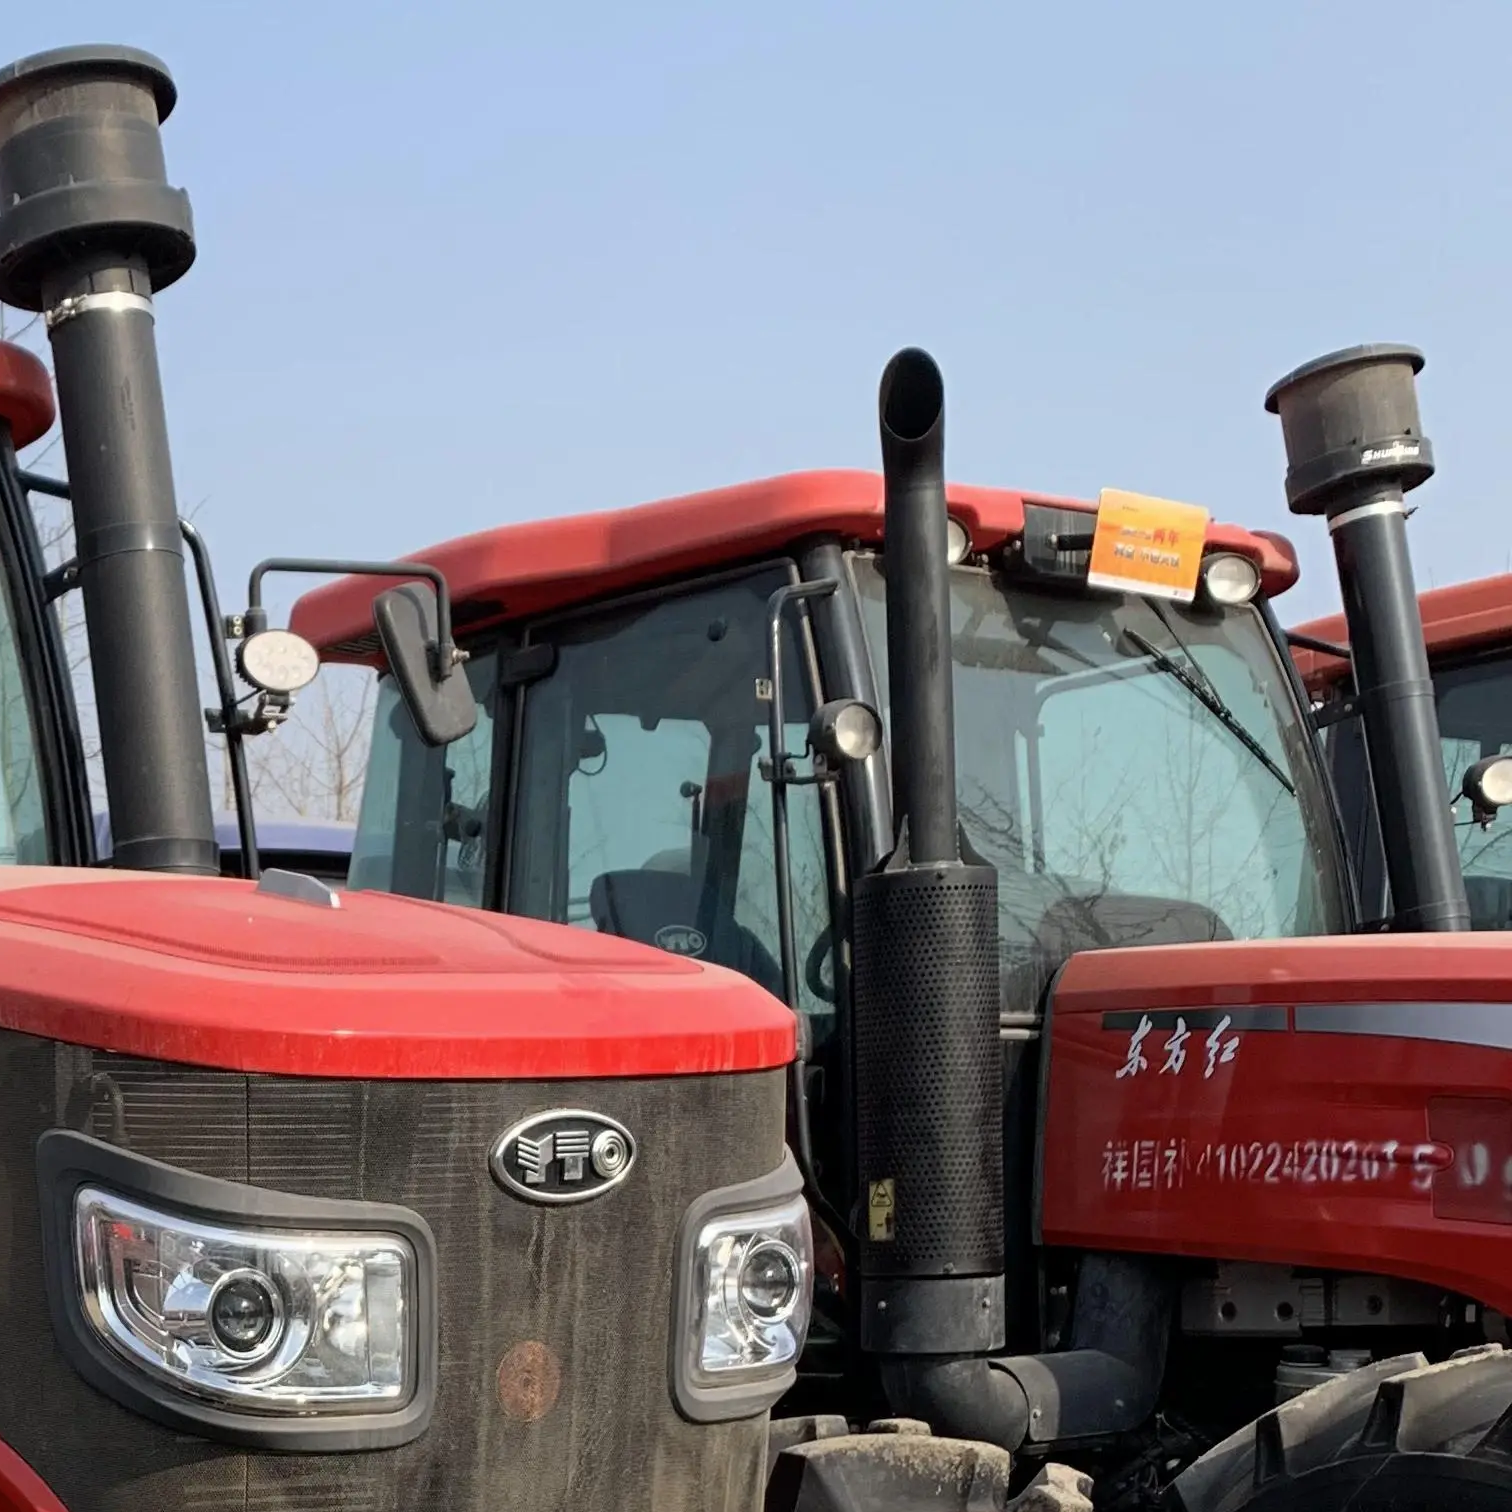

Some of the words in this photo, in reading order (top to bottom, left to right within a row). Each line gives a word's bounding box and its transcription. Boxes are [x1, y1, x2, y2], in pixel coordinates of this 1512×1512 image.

[1115, 1014, 1241, 1080] 东方红
[517, 1130, 628, 1184] YTO
